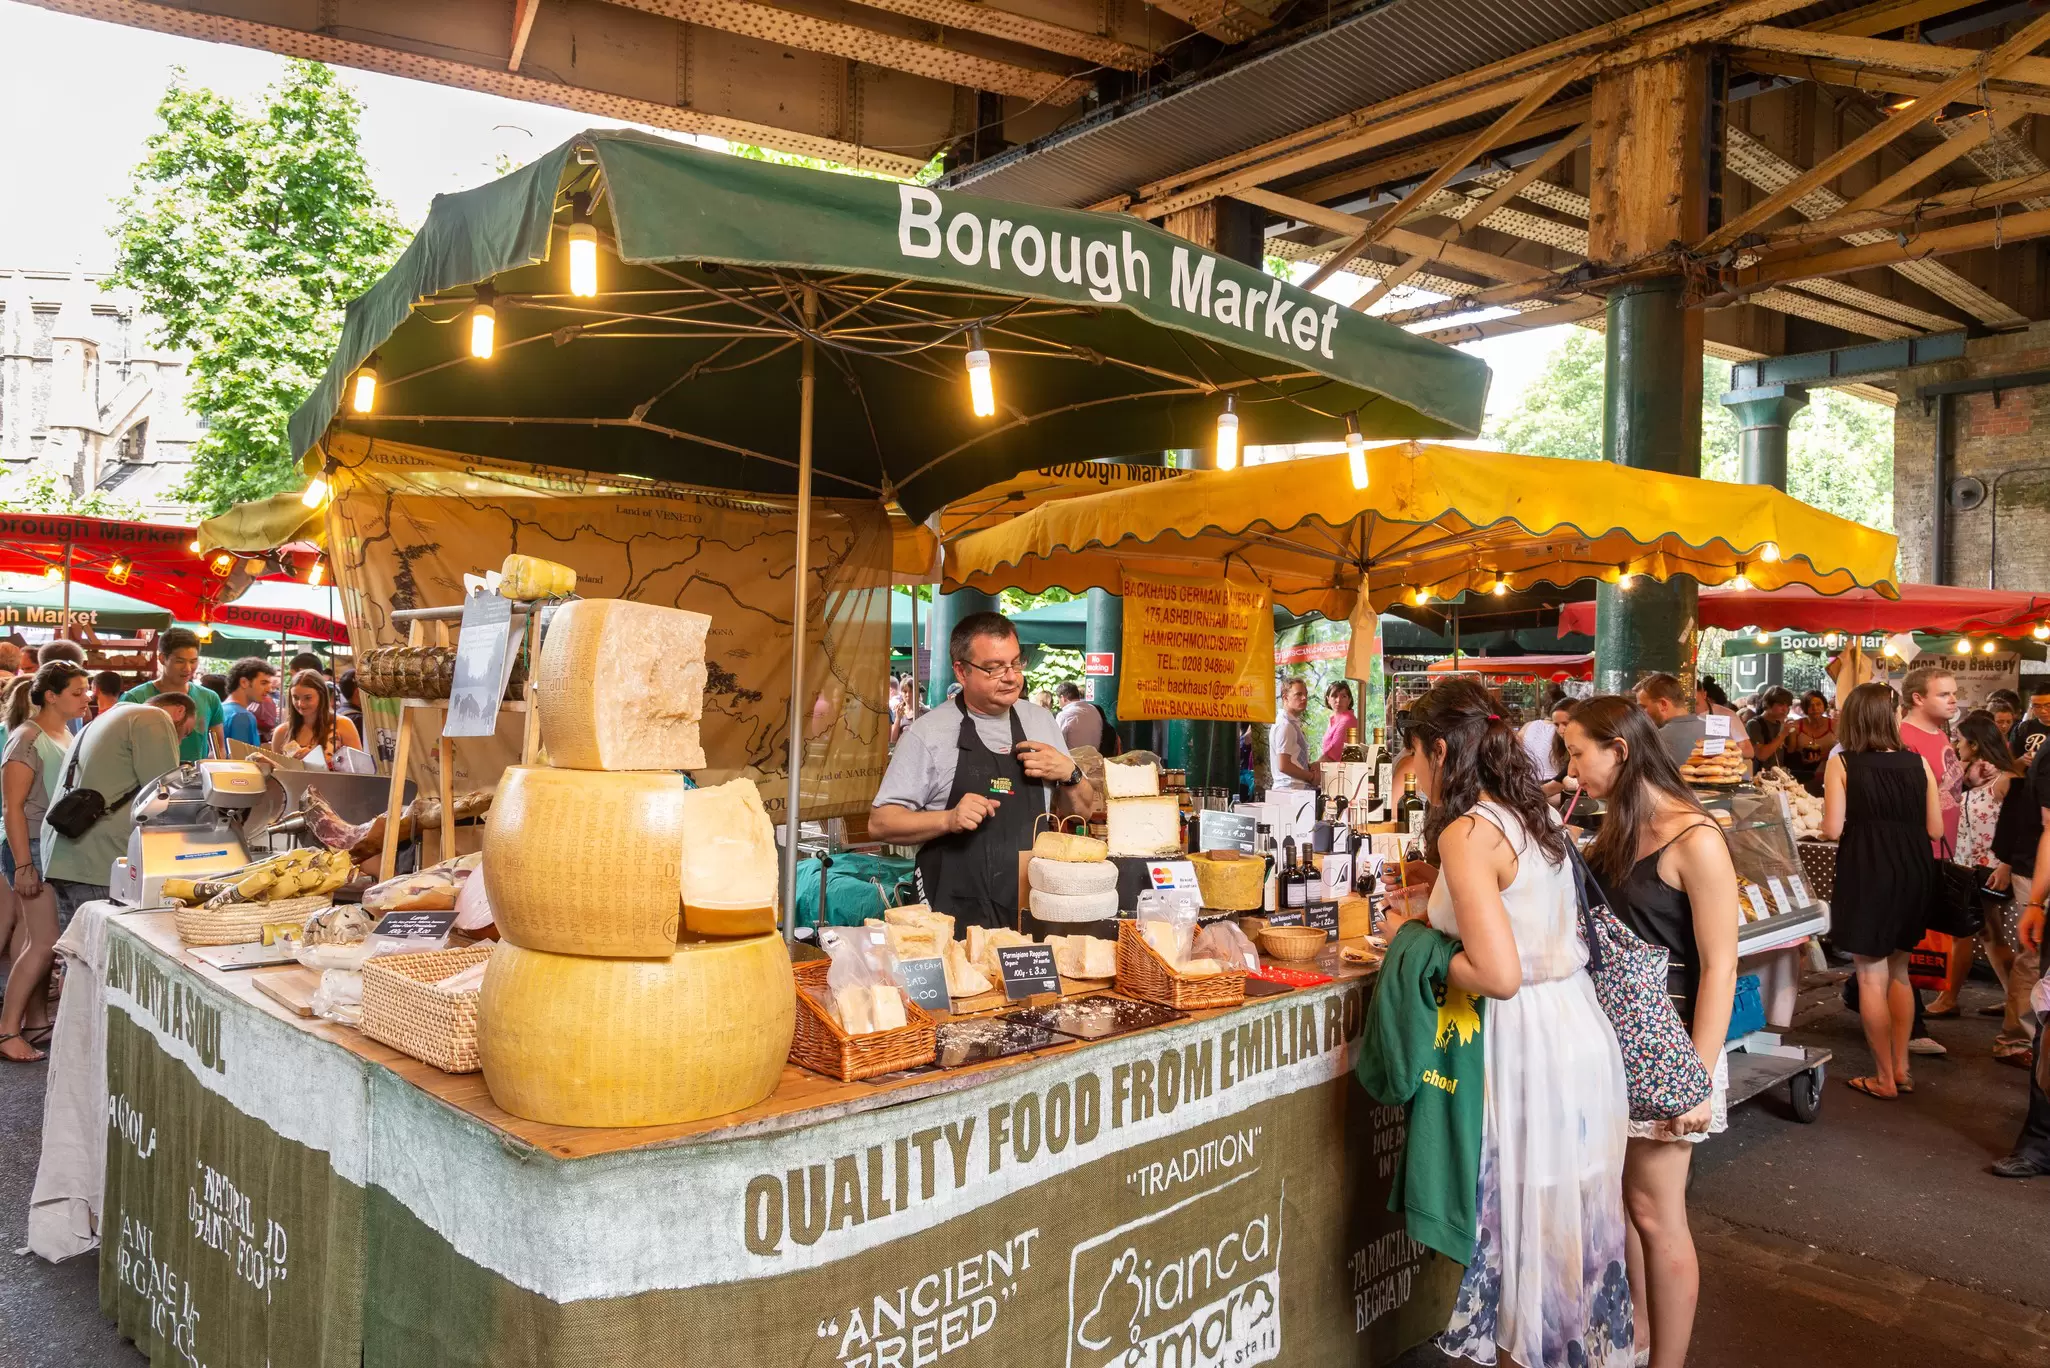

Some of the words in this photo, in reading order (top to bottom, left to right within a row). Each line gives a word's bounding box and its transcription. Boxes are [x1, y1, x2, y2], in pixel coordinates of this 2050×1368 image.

[898, 184, 1150, 303] Borough
[1170, 247, 1339, 360] Market
[616, 505, 640, 516] Land
[642, 508, 653, 517] of
[656, 510, 702, 524] VENETO
[0, 517, 89, 541] orough
[101, 522, 184, 544] Market
[1124, 581, 1176, 600] BACKHAUS
[1180, 586, 1220, 604] GERMAN
[26, 607, 97, 625] Market
[227, 605, 305, 629] Borough
[1143, 629, 1247, 652] HAM/RICHMOND/SURREY
[1091, 655, 1100, 663] No
[1182, 656, 1201, 672] 0208
[1940, 656, 1967, 671] Tree
[1969, 657, 2016, 675] Bakery
[1137, 677, 1164, 692] e-mail:
[1002, 951, 1029, 960] Parmigiano
[1029, 950, 1049, 958] Reggiano
[906, 977, 927, 987] EAD
[1014, 969, 1025, 977] 100g
[172, 981, 183, 1040] A
[185, 985, 226, 1075] SOUL
[1423, 1069, 1458, 1094] chool
[744, 1116, 976, 1256] QUALITY
[988, 1072, 1101, 1174] FOOD
[1112, 1039, 1213, 1128] FROM
[1220, 1005, 1319, 1090] EMILIA
[1324, 986, 1368, 1052] RO
[1127, 1126, 1262, 1196] "TRADITION"
[1234, 1329, 1276, 1364] stall
